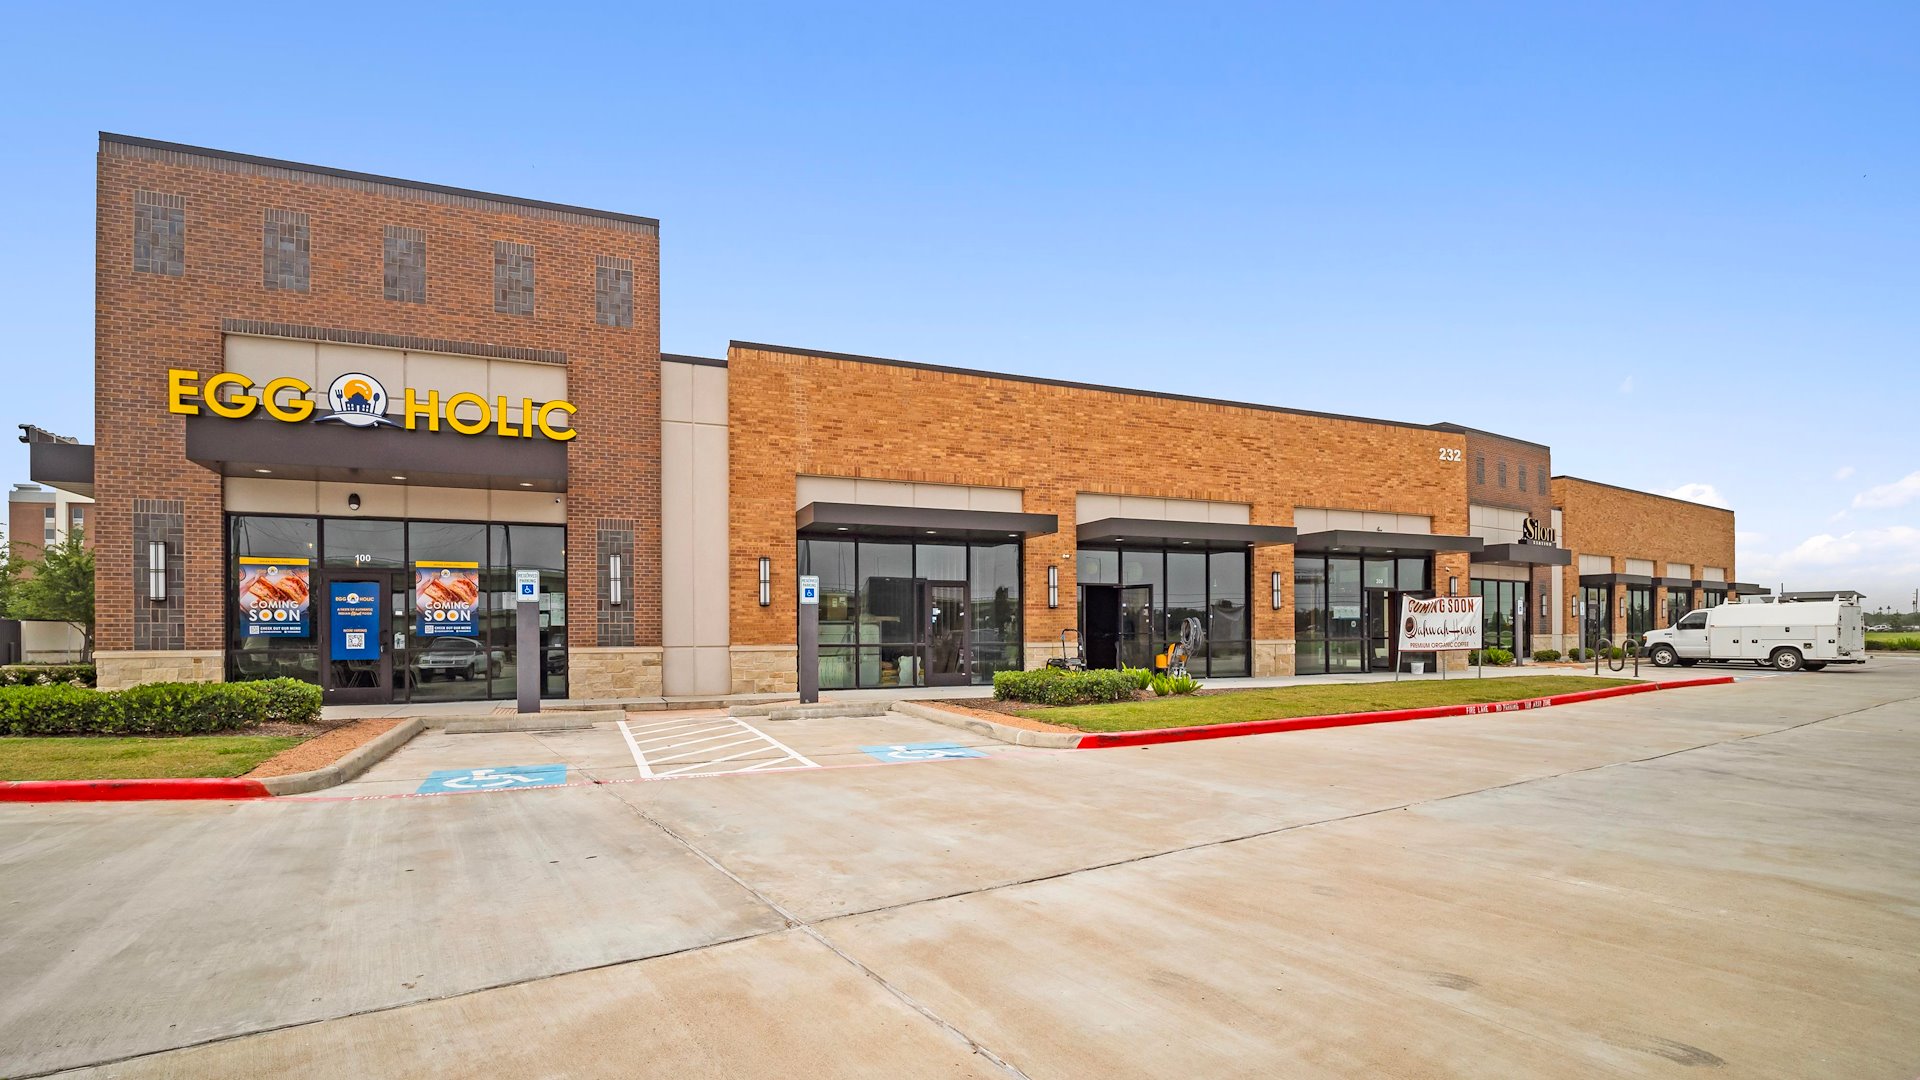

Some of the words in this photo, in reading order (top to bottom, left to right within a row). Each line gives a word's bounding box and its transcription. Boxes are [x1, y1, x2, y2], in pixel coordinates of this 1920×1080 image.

[168, 368, 315, 423] EGG
[404, 388, 577, 441] HOLIC
[1439, 447, 1461, 462] 232
[1525, 517, 1555, 542] Silon
[355, 554, 371, 562] 100
[250, 600, 299, 609] COMING
[425, 601, 470, 610] COMING
[1408, 598, 1445, 614] COMING
[1447, 598, 1474, 613] SOON
[249, 609, 301, 622] SOON
[424, 610, 471, 622] SOON
[1410, 641, 1431, 649] PREMIUM
[1466, 706, 1476, 715] FIRE
[1478, 705, 1489, 714] LANE
[1496, 704, 1502, 712] NO
[1503, 703, 1519, 711] PARKING
